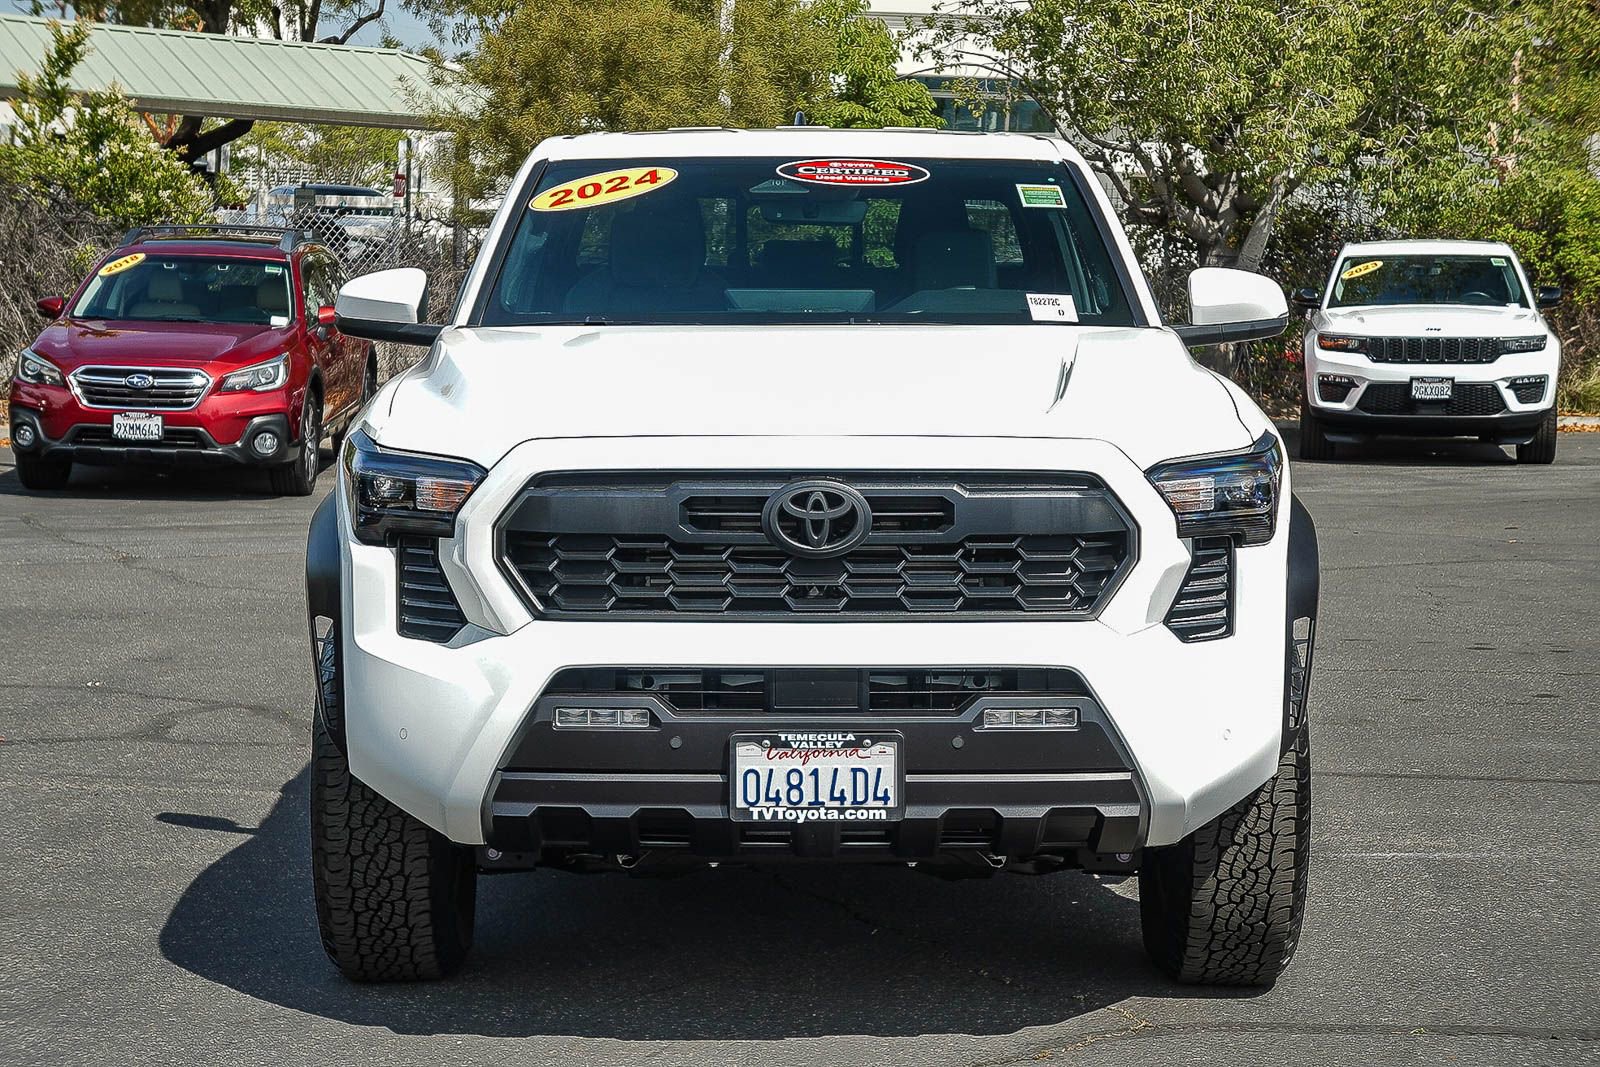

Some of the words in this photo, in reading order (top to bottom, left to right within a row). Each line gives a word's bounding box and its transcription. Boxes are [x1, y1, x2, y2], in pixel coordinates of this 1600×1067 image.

[797, 166, 909, 178] CERTIFIED
[548, 168, 662, 208] 2024
[105, 254, 139, 273] 2018
[1346, 262, 1378, 277] 2023
[778, 733, 855, 742] TEMECULA
[789, 741, 844, 749] VALLEY
[766, 747, 871, 766] California
[742, 767, 891, 807] 04814D4
[749, 806, 888, 824] TVToyota.com
